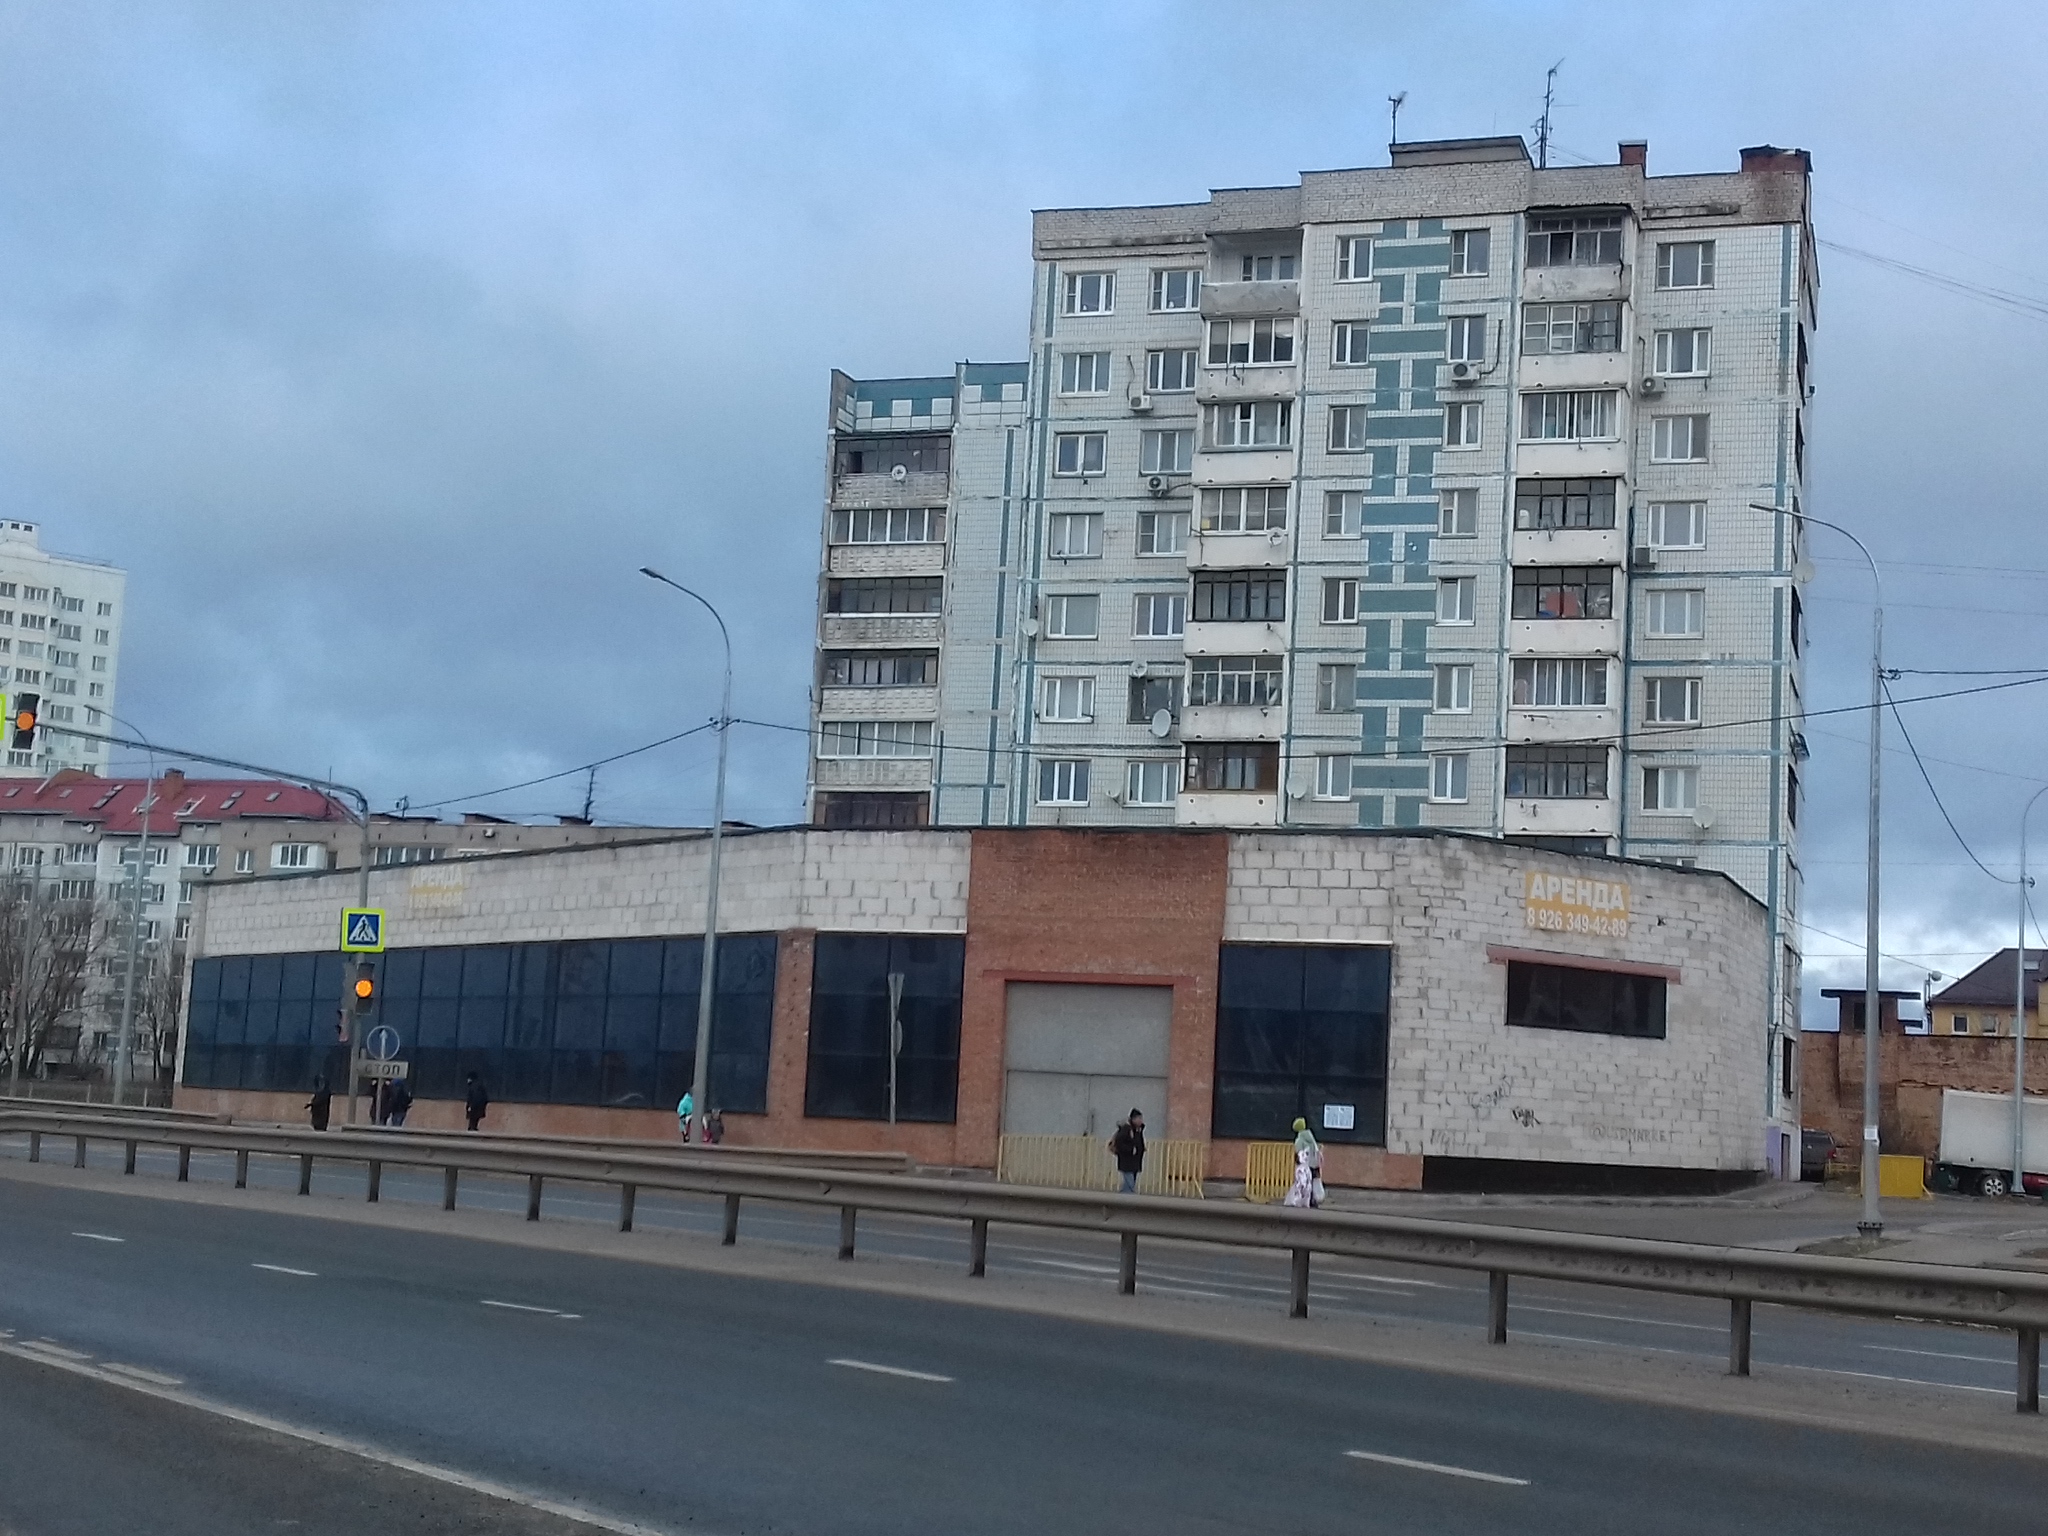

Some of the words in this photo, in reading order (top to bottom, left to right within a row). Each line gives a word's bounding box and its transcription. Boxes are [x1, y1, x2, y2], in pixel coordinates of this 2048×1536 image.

[1530, 873, 1625, 913] АРЕНДА
[1527, 907, 1535, 926] 8
[1540, 909, 1562, 930] 926
